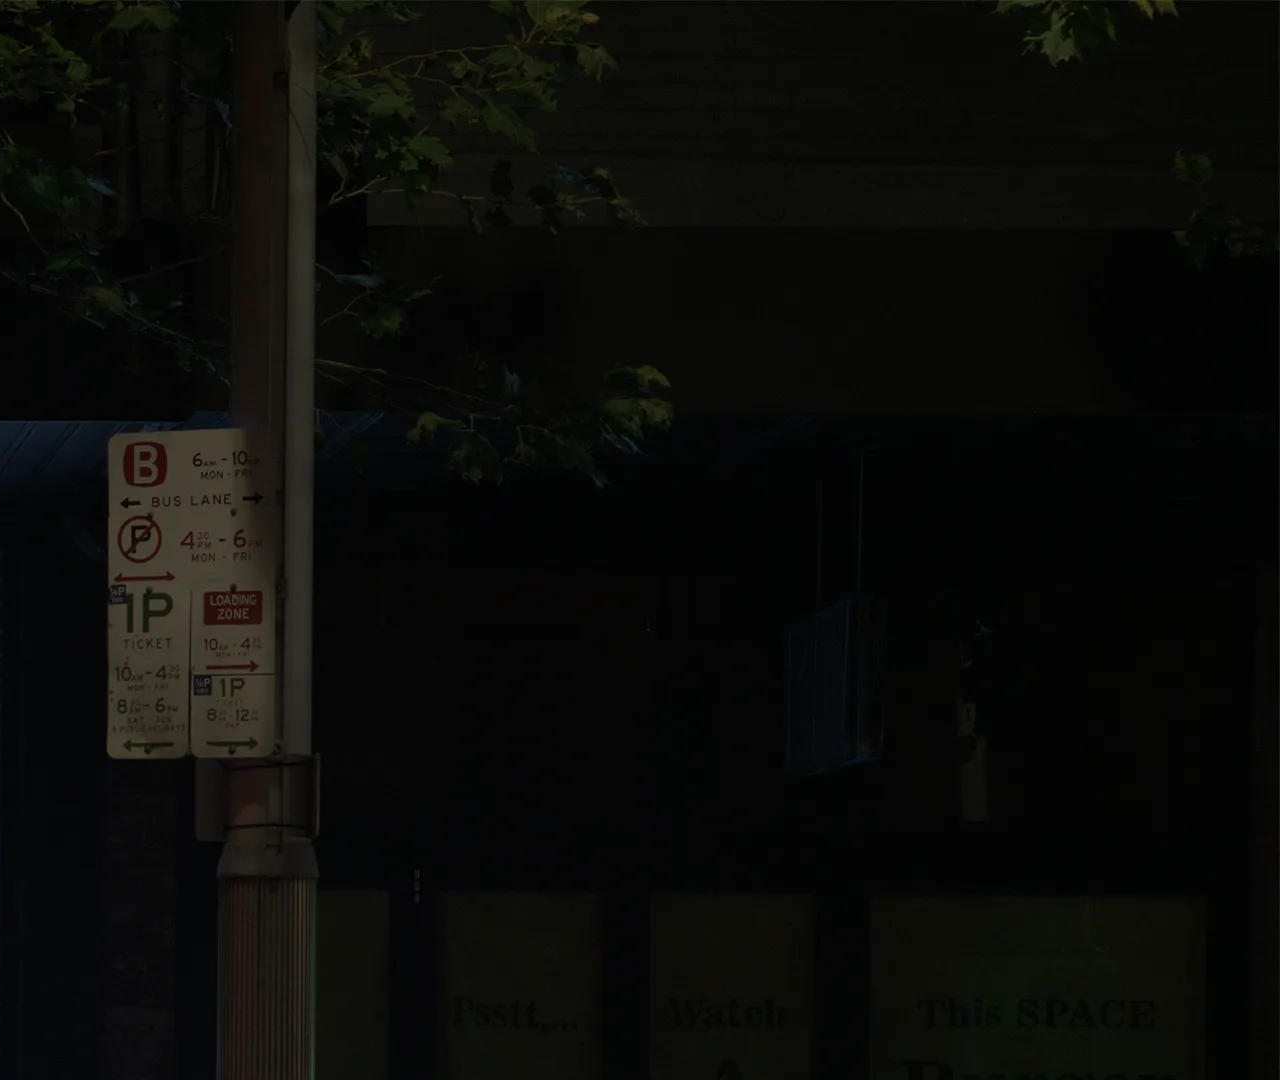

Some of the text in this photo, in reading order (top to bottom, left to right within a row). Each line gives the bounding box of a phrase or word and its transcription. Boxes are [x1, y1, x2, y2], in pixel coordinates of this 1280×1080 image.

[133, 445, 159, 484] B
[201, 469, 252, 480] MON FRI
[151, 494, 231, 508] BUS LANE
[191, 552, 252, 562] MON FRI
[209, 594, 258, 606] LOADING
[127, 593, 173, 633] 1P
[216, 608, 250, 620] ZONE
[123, 638, 172, 650] TICKET
[220, 679, 245, 698] 1P
[667, 997, 785, 1029] Watch
[917, 997, 1155, 1029] This SPACE
